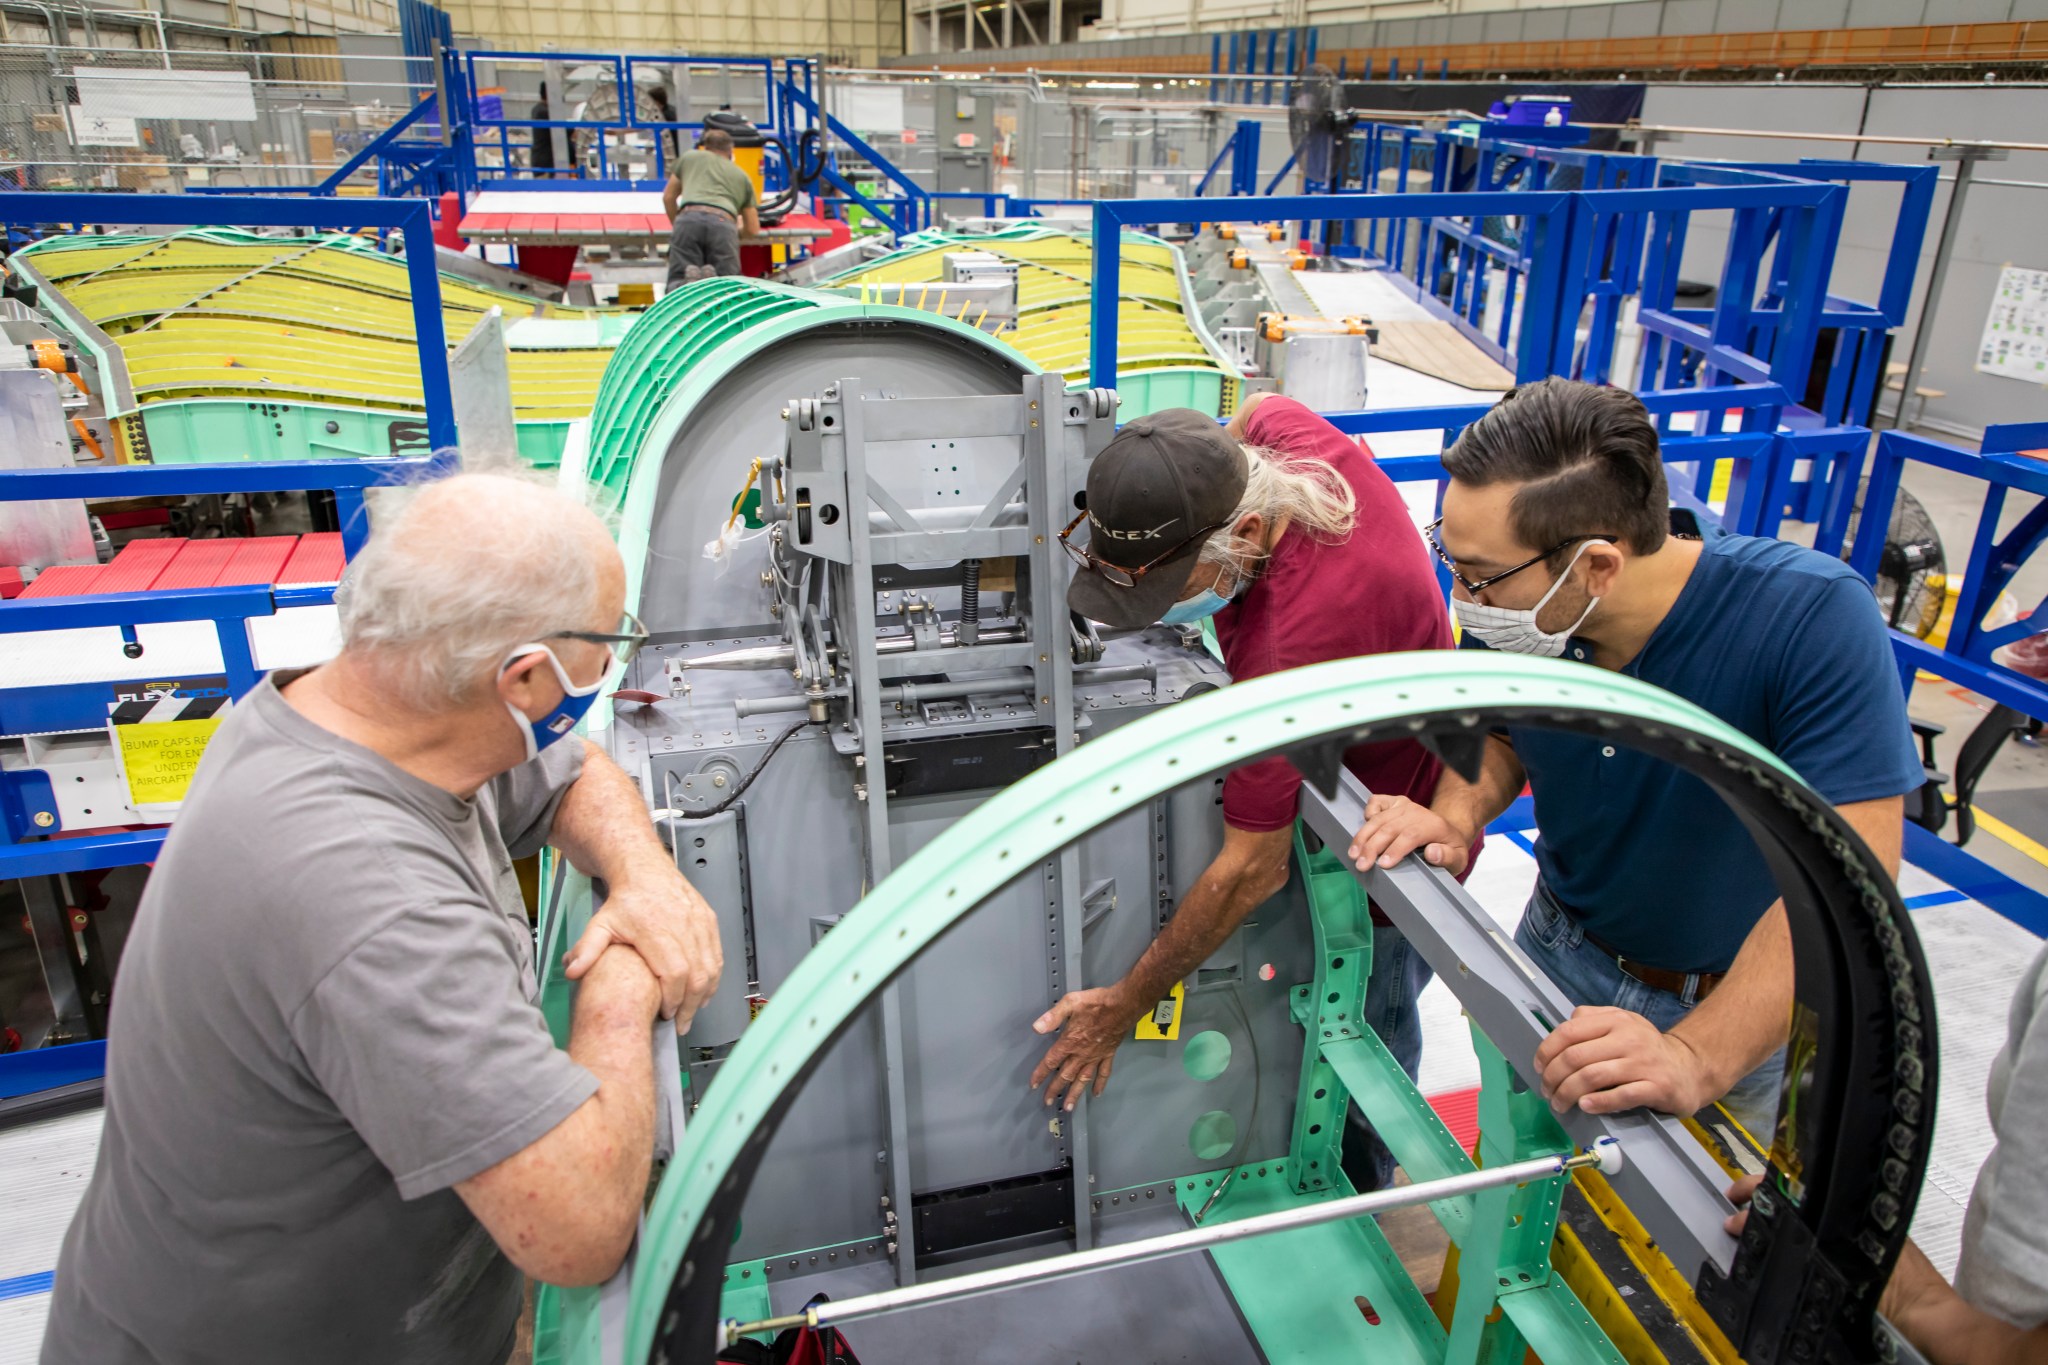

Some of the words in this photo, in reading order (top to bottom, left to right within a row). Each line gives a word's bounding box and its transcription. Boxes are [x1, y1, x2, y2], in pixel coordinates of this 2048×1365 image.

[1089, 509, 1180, 540] SPACEX
[125, 740, 160, 750] BUMP
[162, 737, 191, 748] CAPS
[160, 750, 183, 760] FOR
[136, 773, 188, 786] AIRCRAFT
